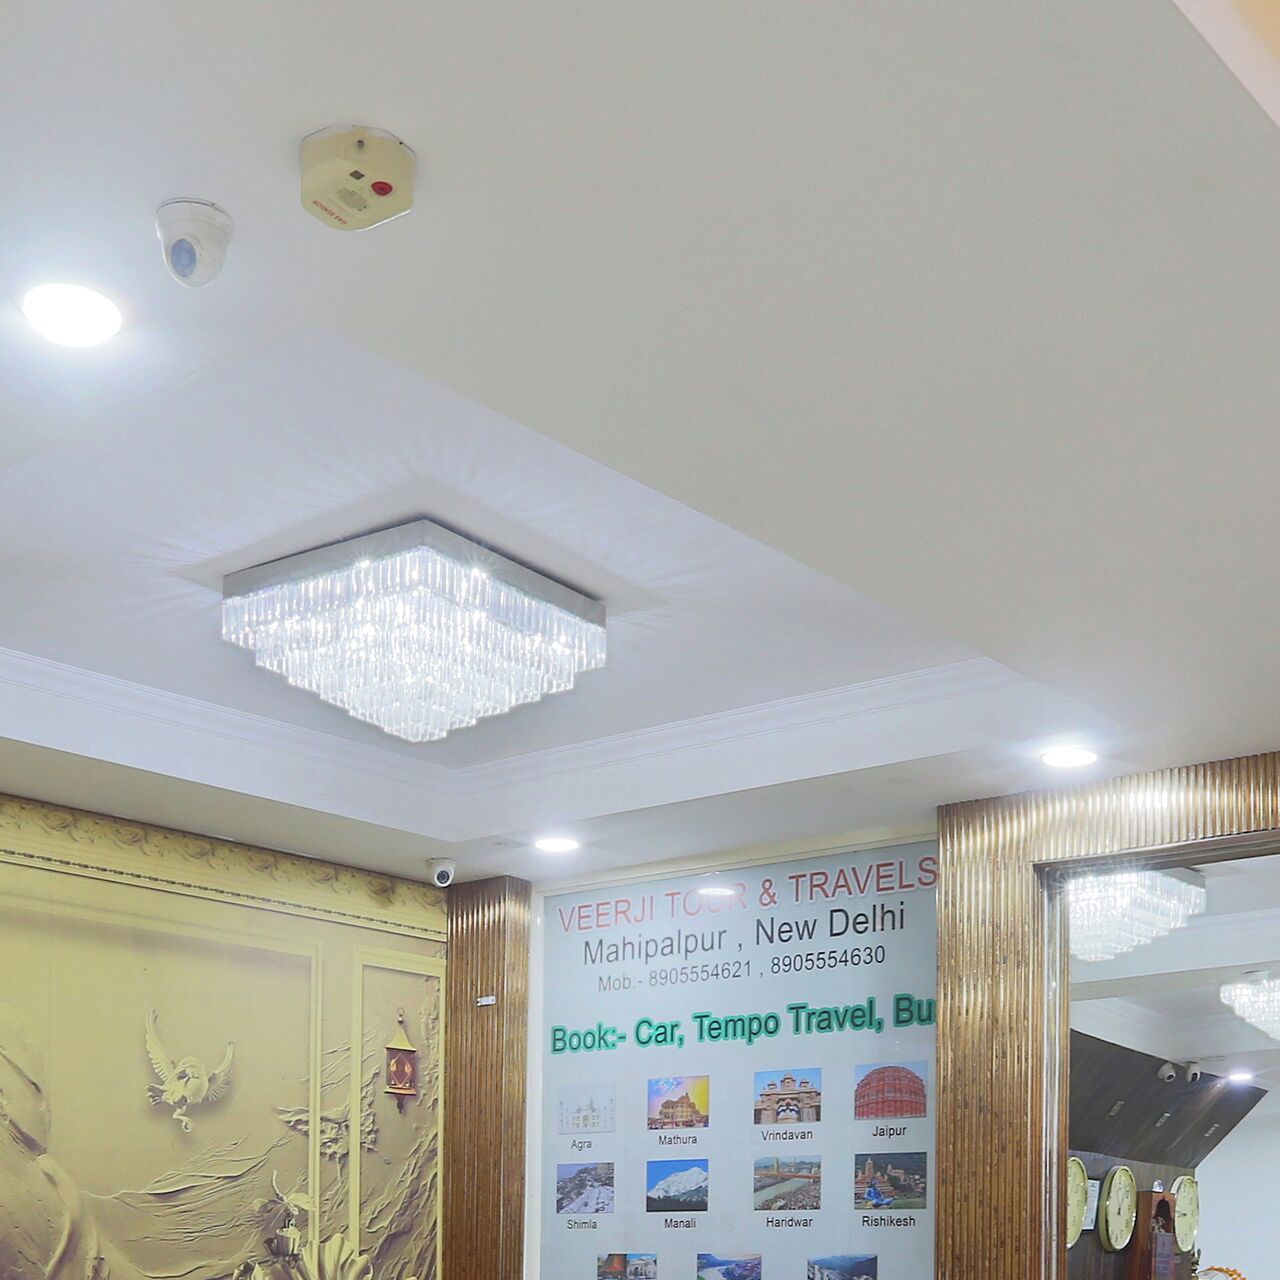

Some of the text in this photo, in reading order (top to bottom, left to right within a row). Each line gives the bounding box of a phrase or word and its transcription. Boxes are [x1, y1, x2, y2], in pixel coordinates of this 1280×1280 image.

[558, 895, 654, 933] VEERJI
[759, 878, 778, 907] &
[788, 856, 938, 903] TRAVELS
[583, 926, 728, 966] Mahipalpur
[755, 915, 817, 947] New
[829, 901, 905, 937] Delhi
[598, 972, 643, 993] Mob:-
[649, 960, 751, 988] 8905554621
[771, 945, 886, 976] 8905554630
[551, 1022, 626, 1055] Book:-
[634, 1018, 685, 1049] Car,
[692, 1010, 780, 1046] Tempo
[788, 997, 883, 1035] Travel,
[761, 1129, 813, 1142] Vrindavan
[872, 1125, 907, 1140] Jaipur
[570, 1139, 592, 1151] Agra
[658, 1133, 698, 1146] Mathura
[567, 1218, 597, 1230] Shimla
[664, 1217, 697, 1229] Manali
[766, 1216, 813, 1229] Haridwar
[861, 1215, 916, 1228] Rishikesh
